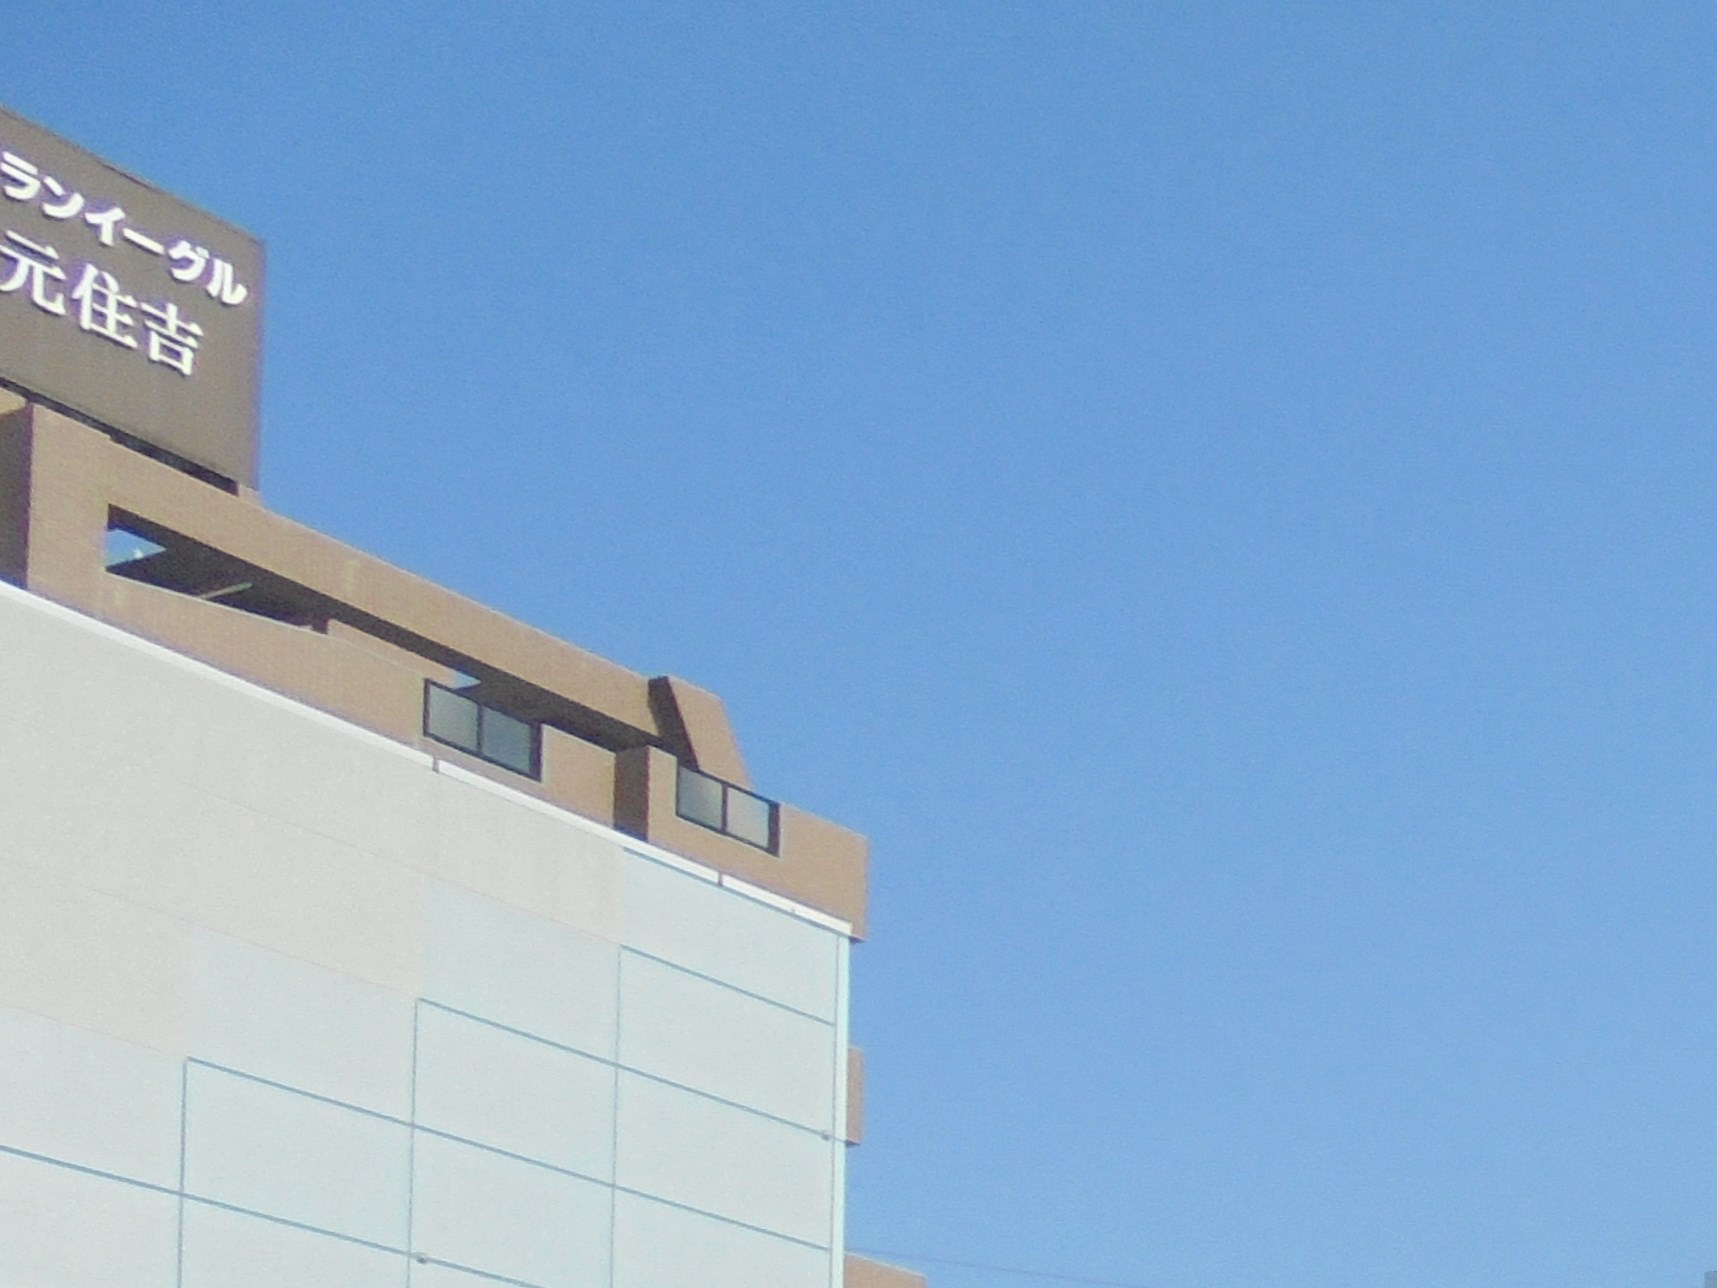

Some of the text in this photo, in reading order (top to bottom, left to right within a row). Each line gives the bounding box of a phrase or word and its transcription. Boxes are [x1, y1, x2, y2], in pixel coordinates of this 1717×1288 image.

[0, 150, 248, 306] ランイーグル
[0, 230, 204, 376] 元住吉
